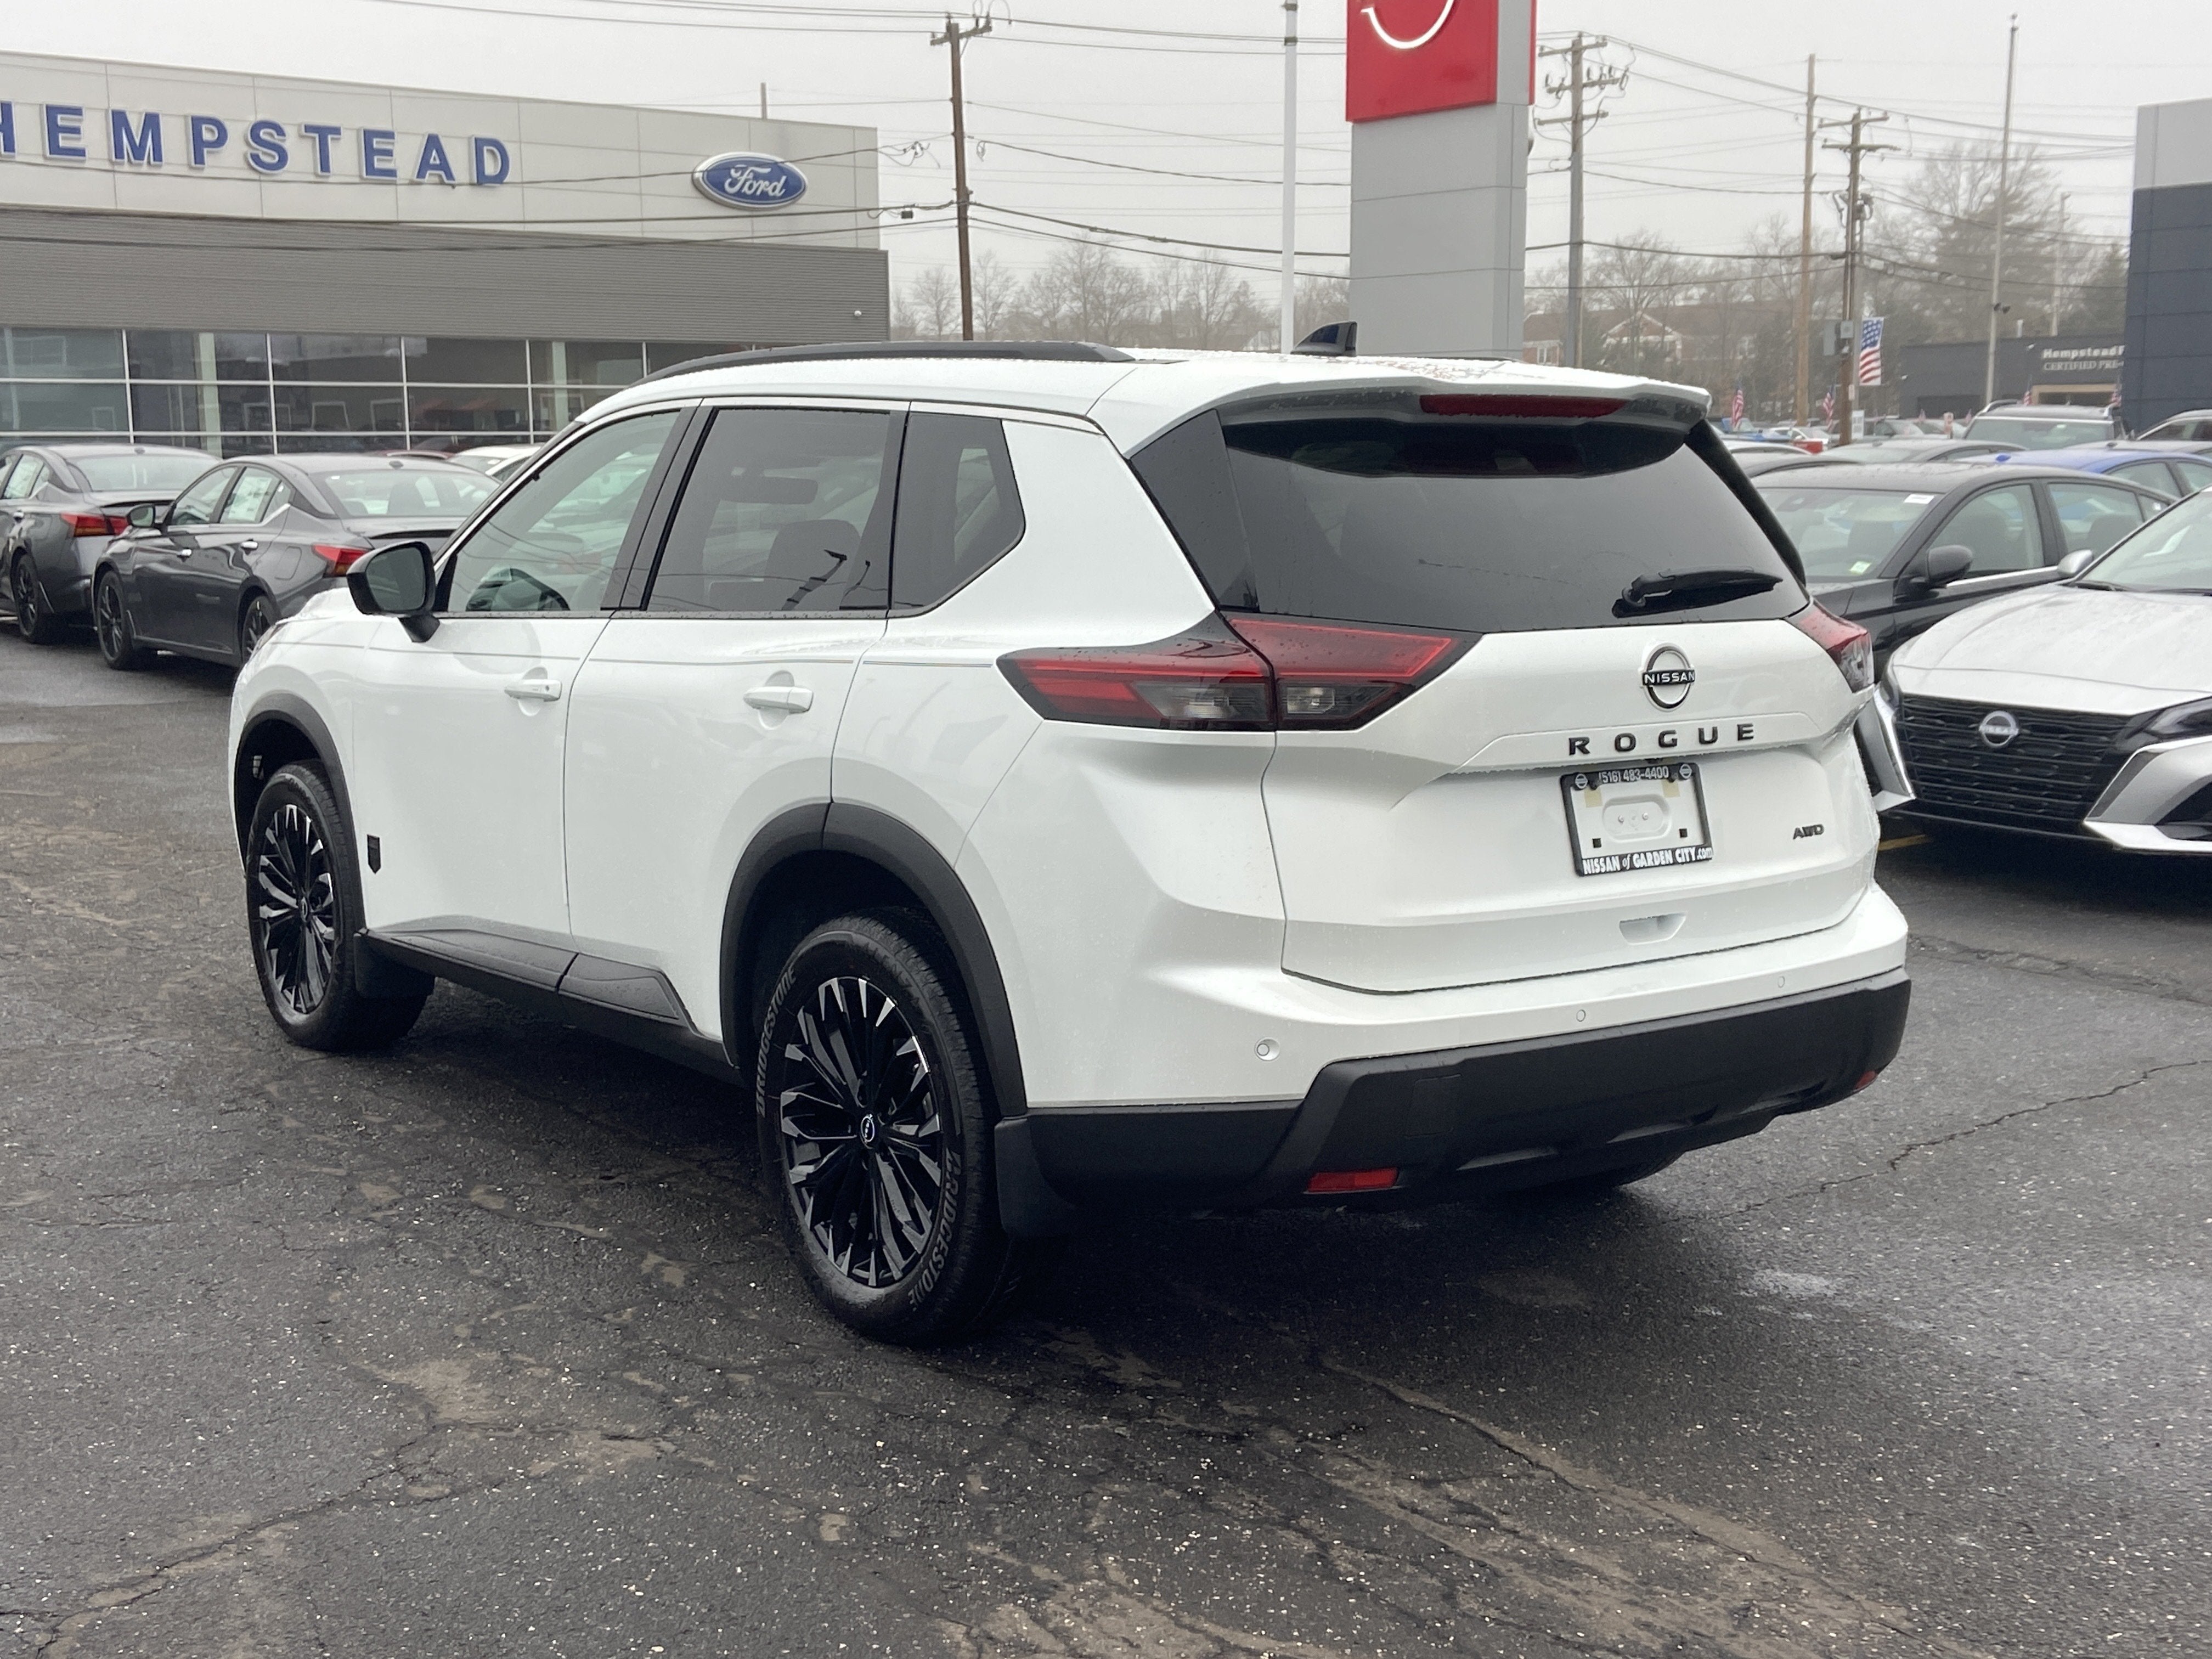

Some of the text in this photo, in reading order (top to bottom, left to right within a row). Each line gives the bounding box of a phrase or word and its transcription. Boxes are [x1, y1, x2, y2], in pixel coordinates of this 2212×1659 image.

[724, 164, 787, 197] Ford
[2044, 360, 2097, 371] CERTIFIED
[1644, 672, 1695, 684] NISSAN
[1568, 723, 1754, 755] ROGUE
[1599, 766, 1669, 783] (516) 483-4400
[1792, 824, 1825, 839] AWD
[1583, 855, 1621, 875] NISSAN
[1622, 854, 1631, 870] of
[1633, 849, 1673, 868] GARDEN
[757, 961, 796, 1118] BRIDGESTONE
[908, 1147, 961, 1311] BRIDGESTONE
